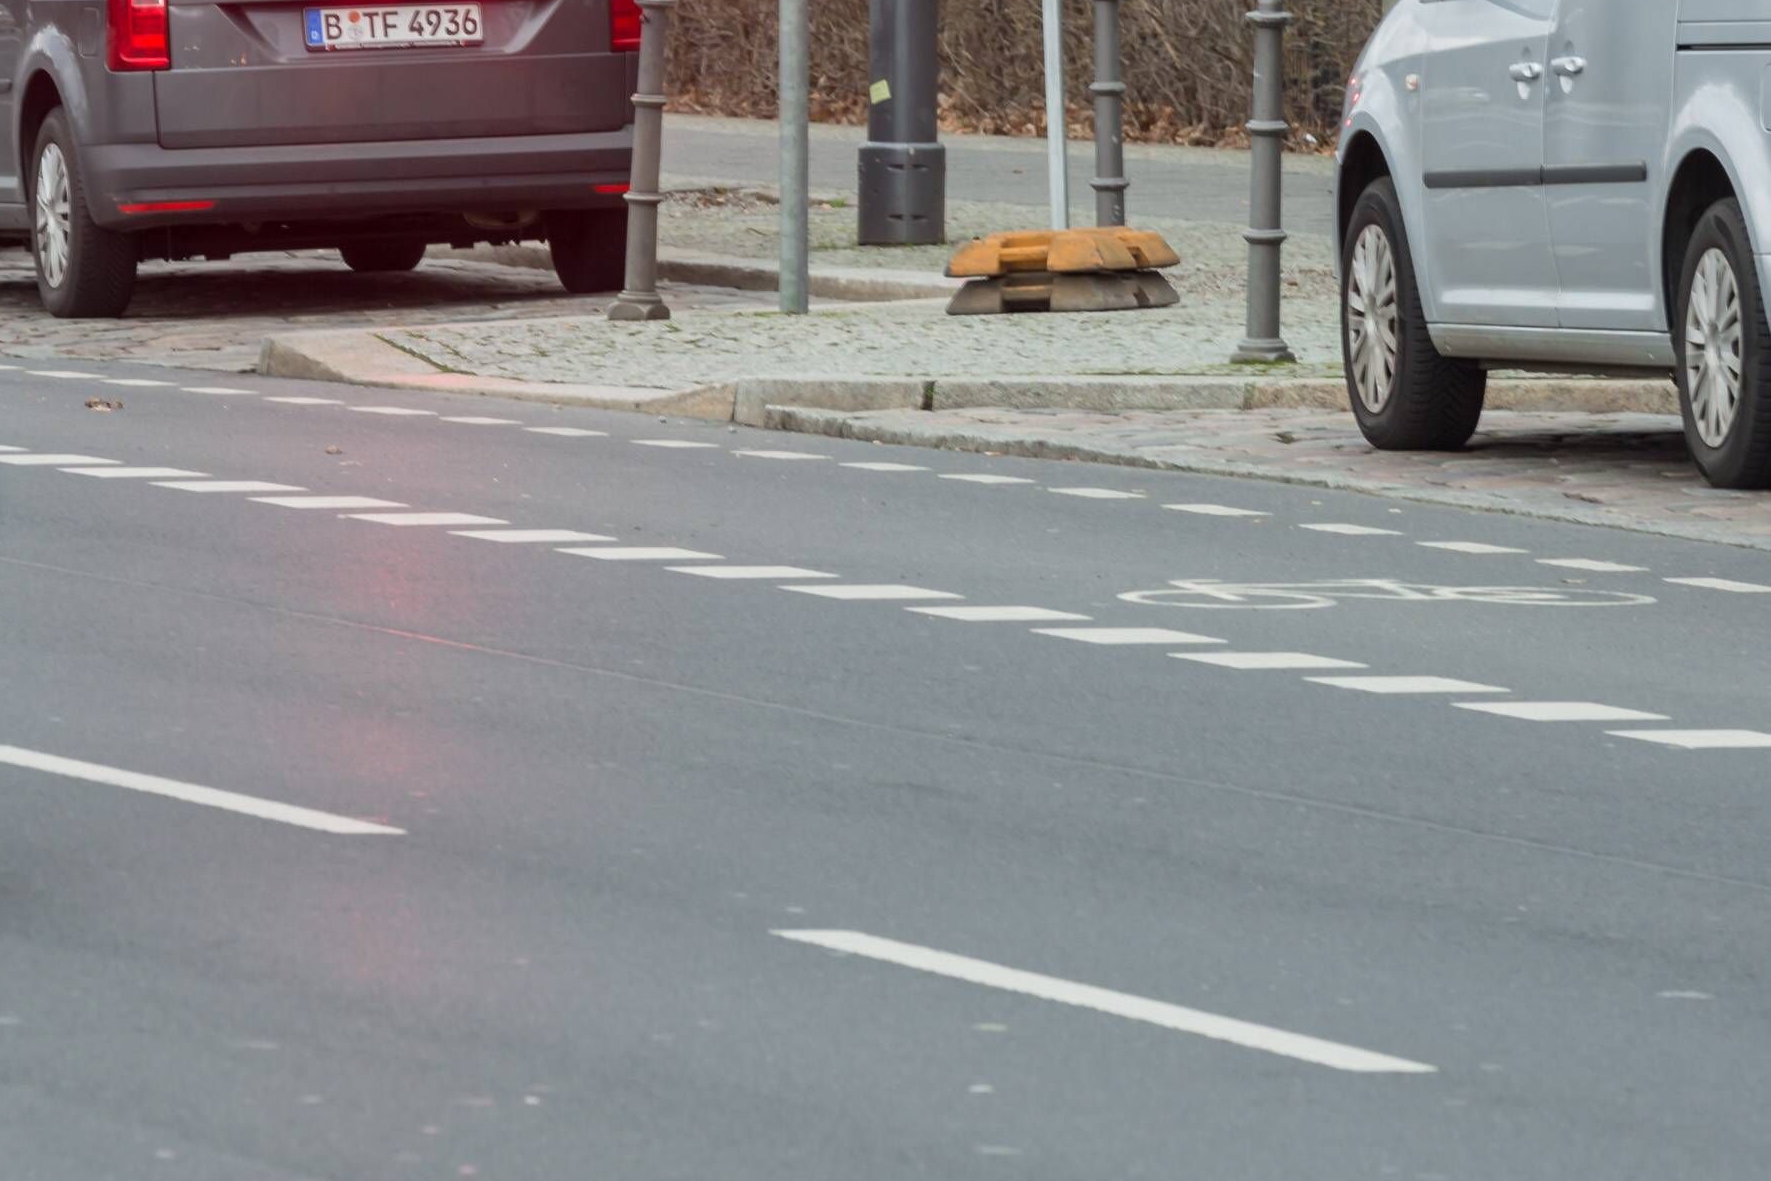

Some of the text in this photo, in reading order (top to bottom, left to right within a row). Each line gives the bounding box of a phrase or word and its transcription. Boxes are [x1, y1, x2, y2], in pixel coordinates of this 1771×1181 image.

[324, 14, 342, 40] B
[363, 11, 398, 39] TF
[408, 9, 478, 37] 4936
